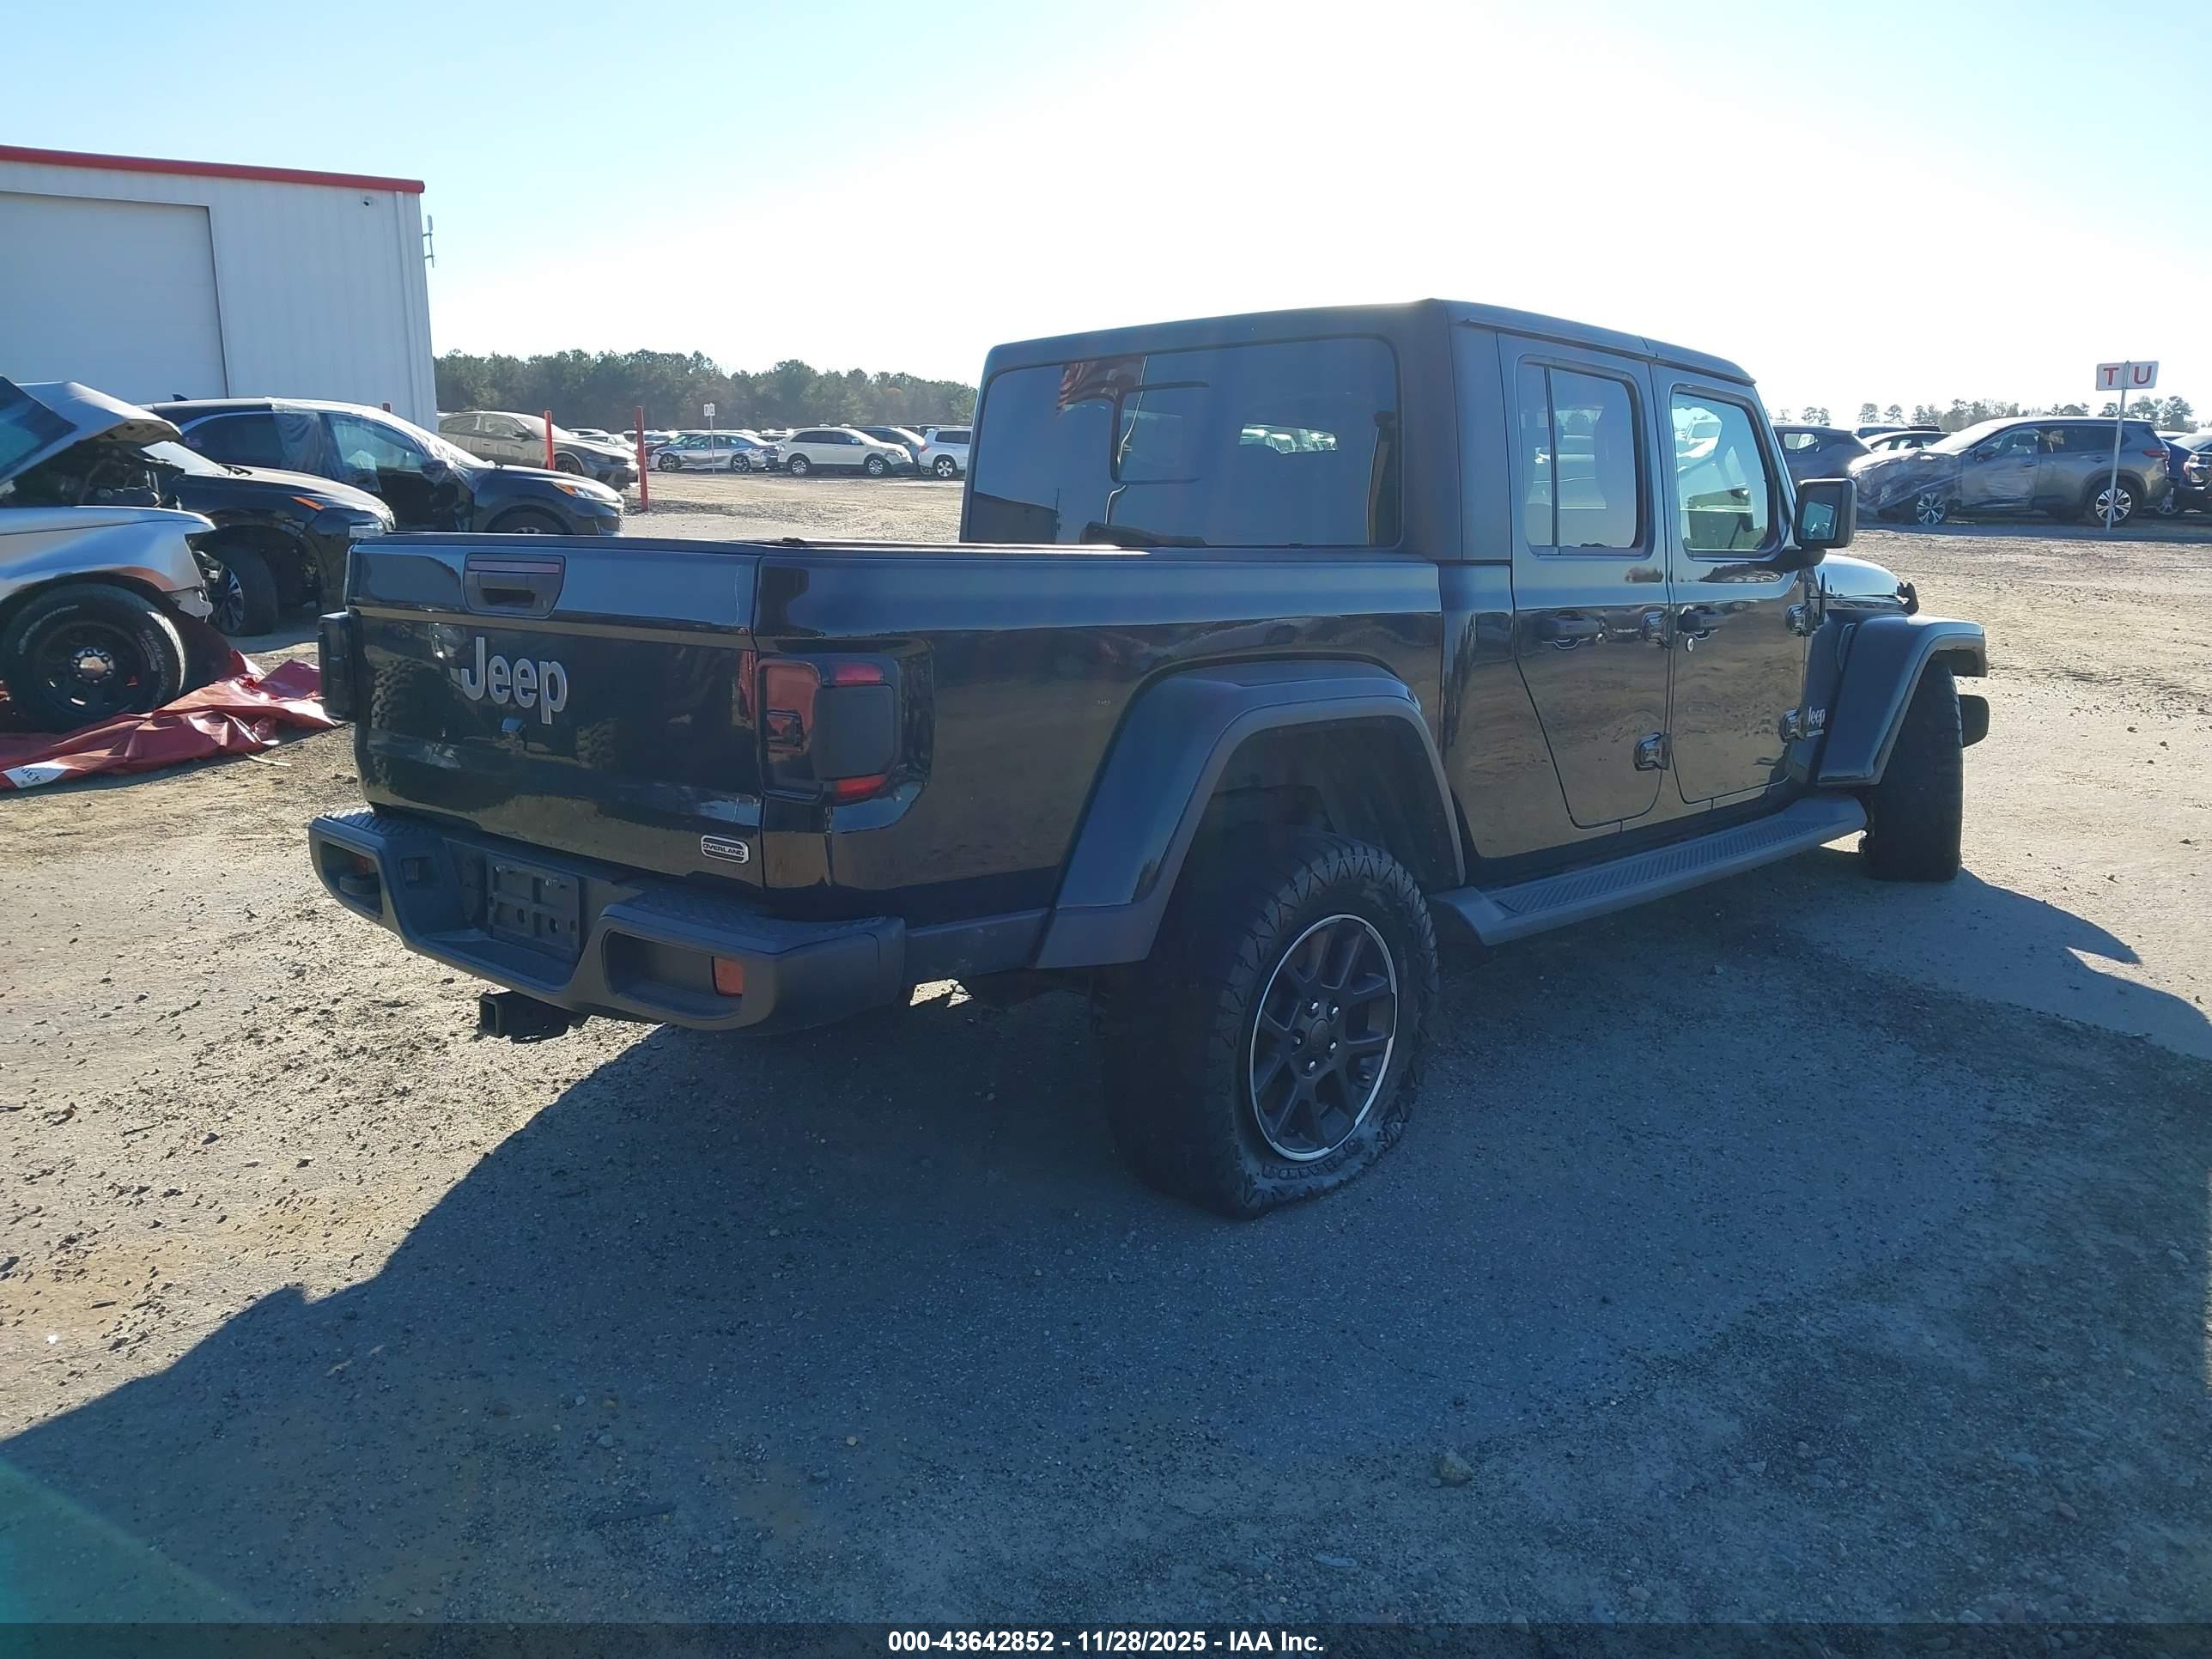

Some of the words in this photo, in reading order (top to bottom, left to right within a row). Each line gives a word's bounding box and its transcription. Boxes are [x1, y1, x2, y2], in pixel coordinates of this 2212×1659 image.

[2102, 367, 2120, 386] T
[2134, 365, 2153, 385] U
[460, 636, 568, 725] Jeep
[1807, 706, 1826, 728] Jeep
[702, 843, 744, 857] OVERLAND
